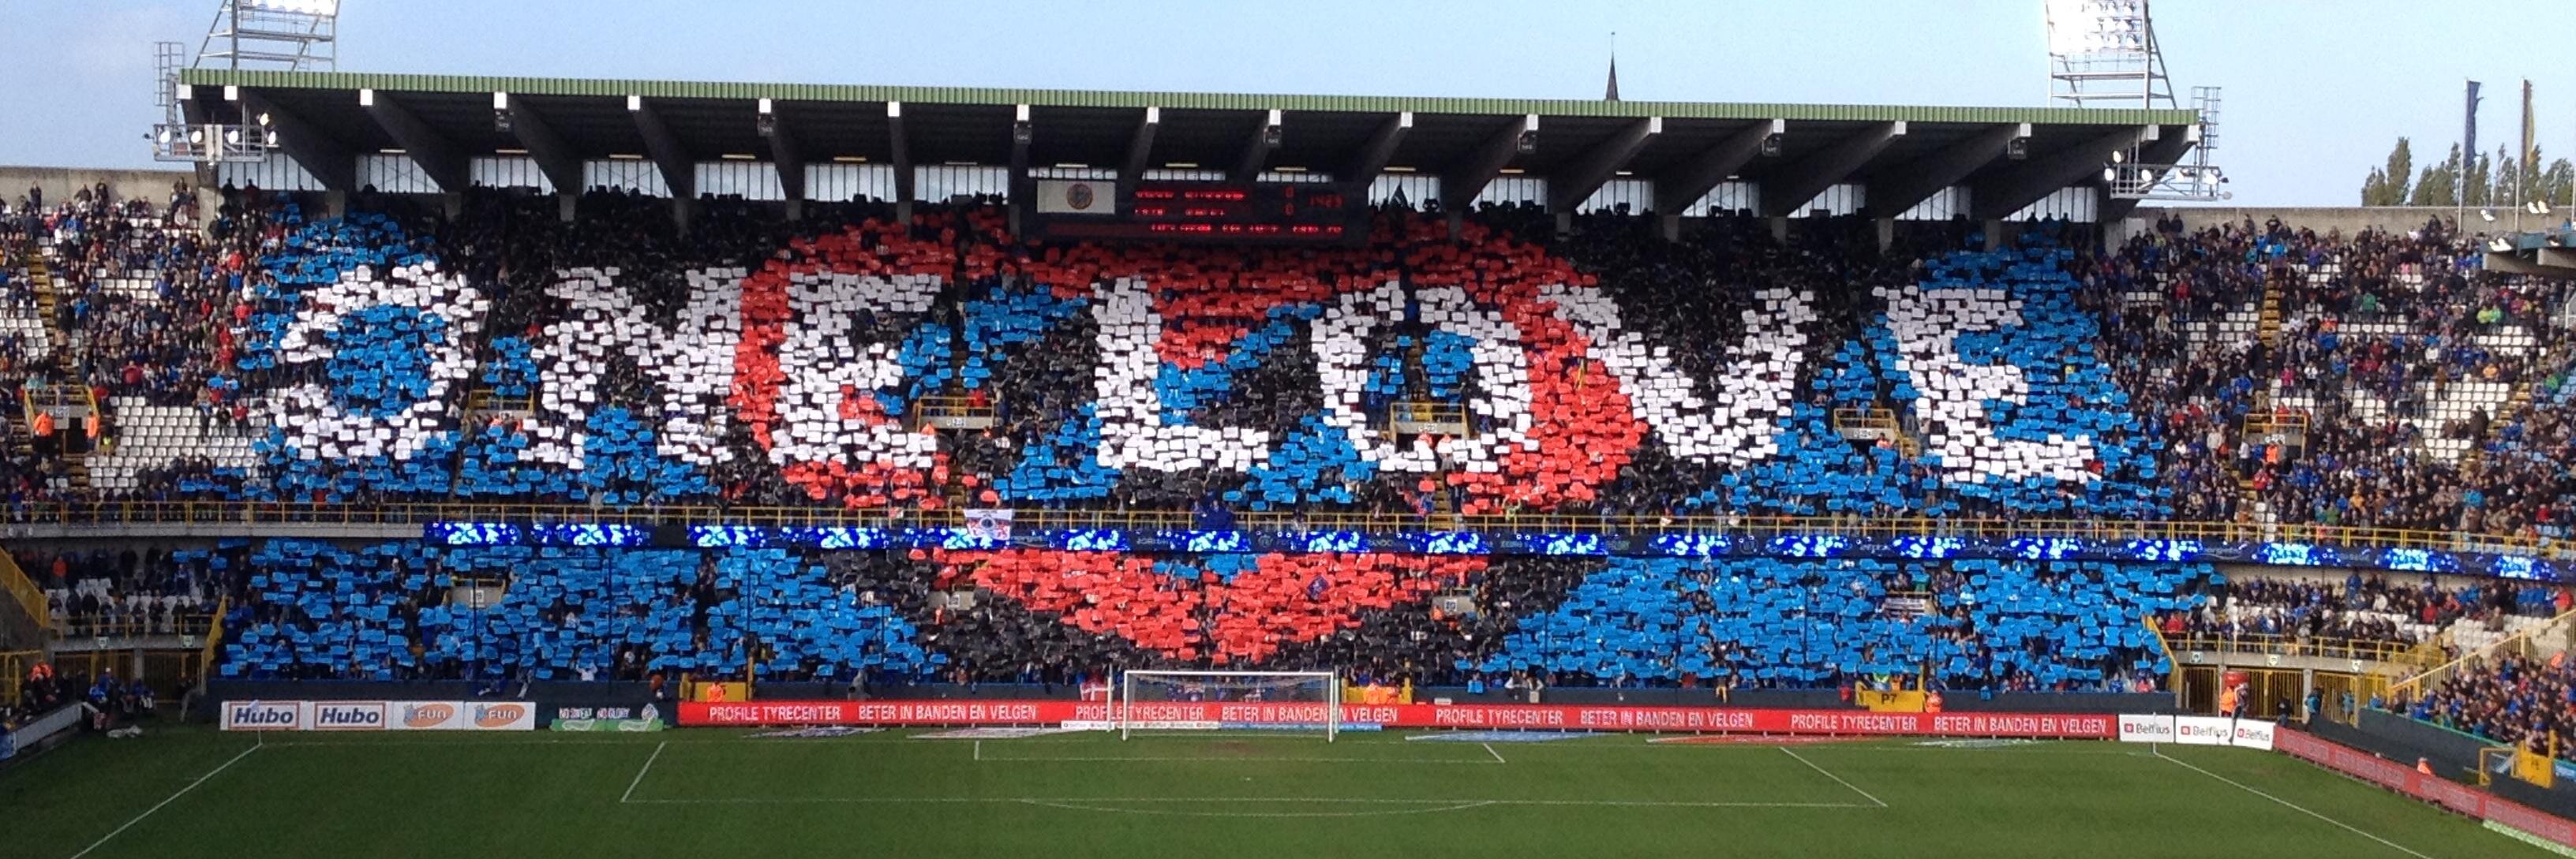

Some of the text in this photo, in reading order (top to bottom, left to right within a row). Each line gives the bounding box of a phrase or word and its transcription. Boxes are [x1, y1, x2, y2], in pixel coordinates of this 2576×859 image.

[268, 262, 2095, 483] ONE LOVE
[1881, 693, 1897, 704] P7
[234, 708, 294, 724] Hubo
[320, 708, 380, 724] Hubo
[710, 705, 841, 721] PROFILE TYRECENTER
[859, 705, 1036, 721] BETER IN BANDEN EN VELGEN
[1076, 705, 1204, 721] PROFLE TYRECENTER
[1222, 707, 1260, 721] BETER
[1263, 707, 1275, 721] IN
[1279, 707, 1328, 721] BANDEN
[1350, 708, 1398, 722] VELGEN
[1436, 708, 1563, 724] PROFILE TYRECENTER
[1580, 710, 1754, 727] BETER IN BANDEN EN VELGEN
[1792, 714, 1917, 730] PROFILE TYRECENTER
[1934, 716, 2106, 733] BETER IN BANDEN EN VELGEN
[2136, 723, 2170, 734] Belfius
[2192, 725, 2228, 737] Belfius
[2245, 728, 2270, 741] Belfius
